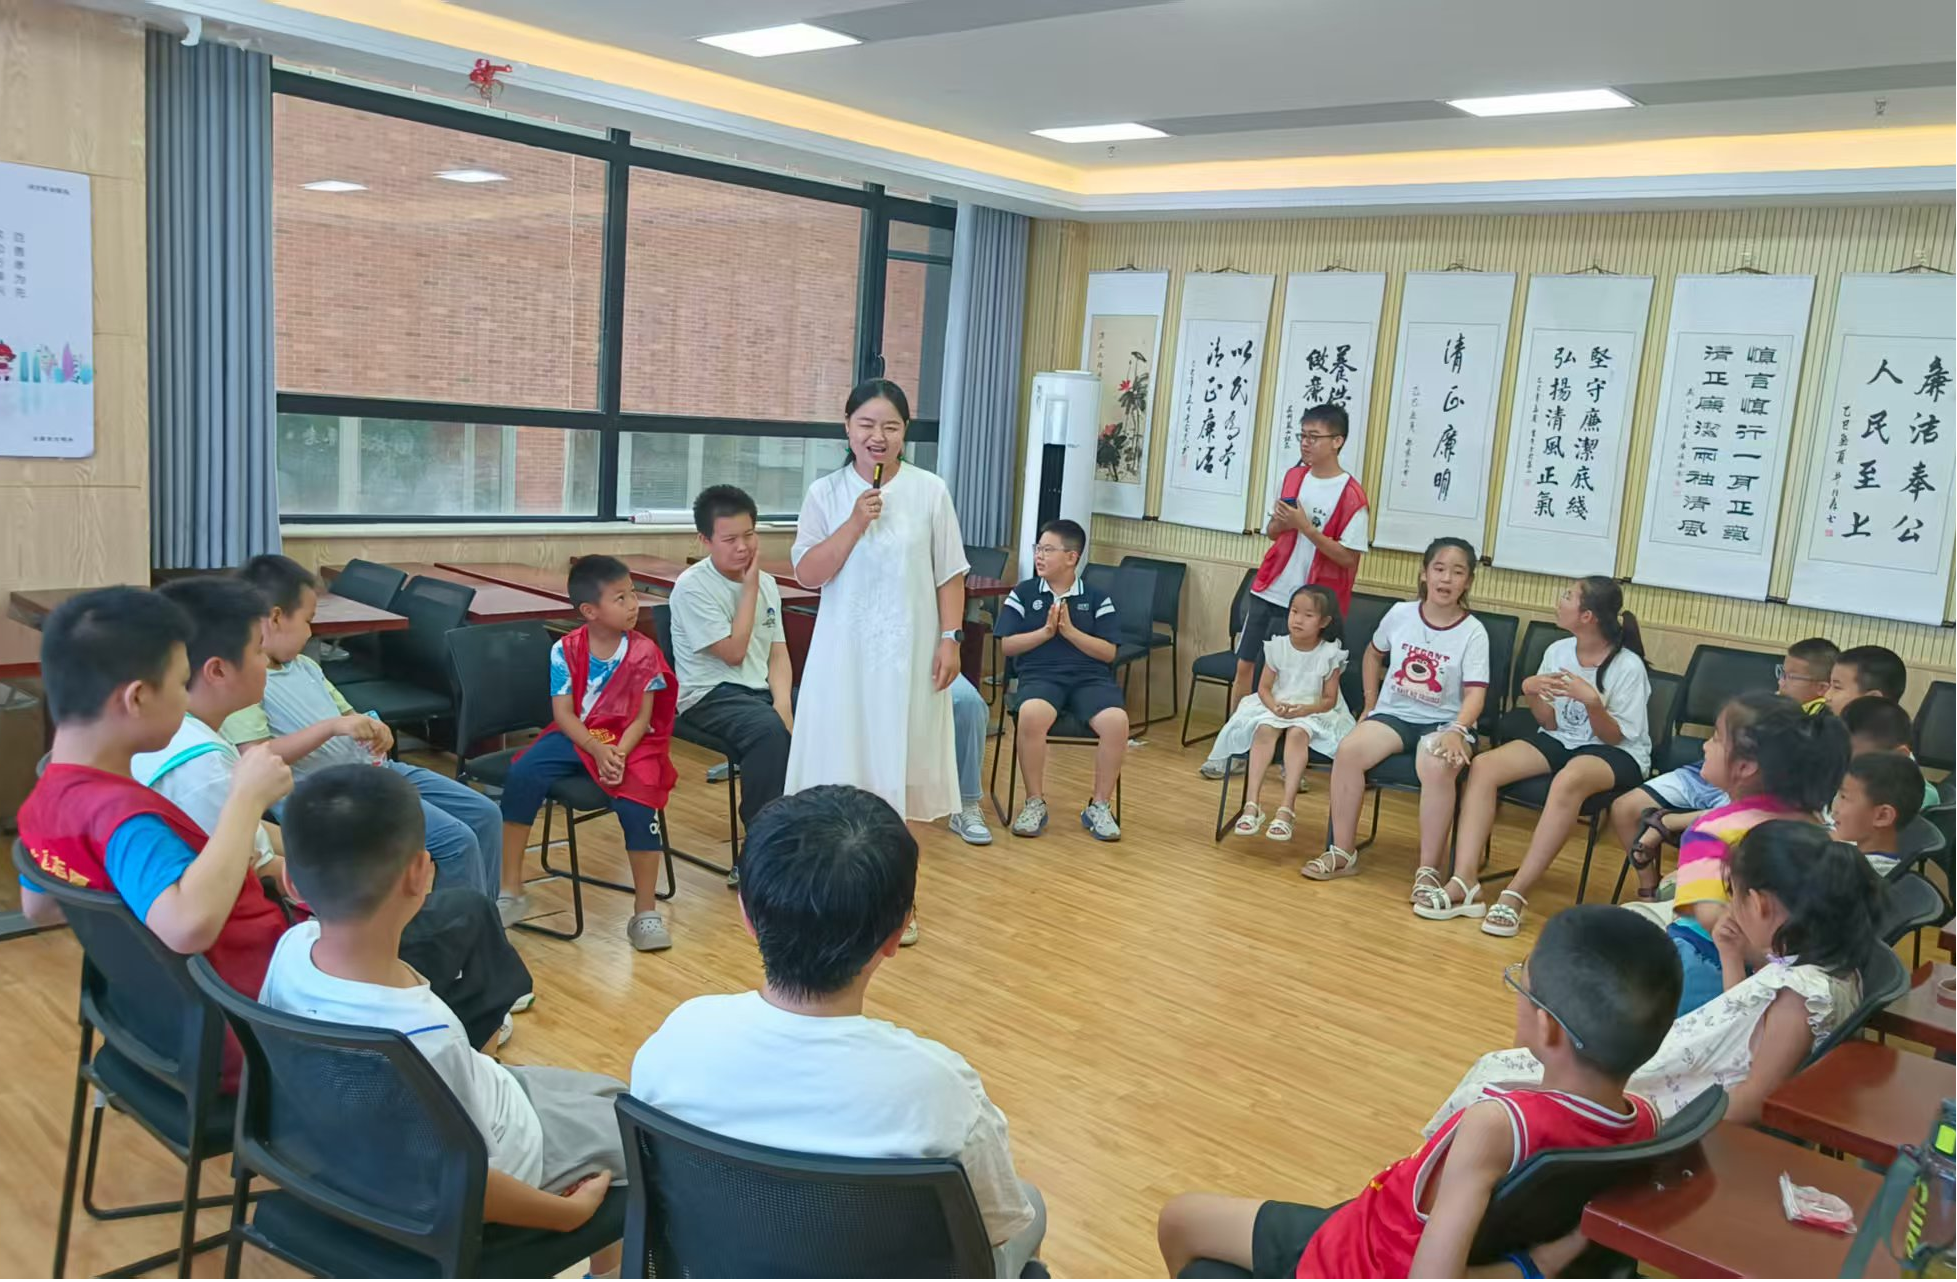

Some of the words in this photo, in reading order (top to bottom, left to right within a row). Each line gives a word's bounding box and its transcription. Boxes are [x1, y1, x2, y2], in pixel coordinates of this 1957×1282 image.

[1841, 358, 1904, 538] 人民至上
[1401, 643, 1450, 662] ELEGANT
